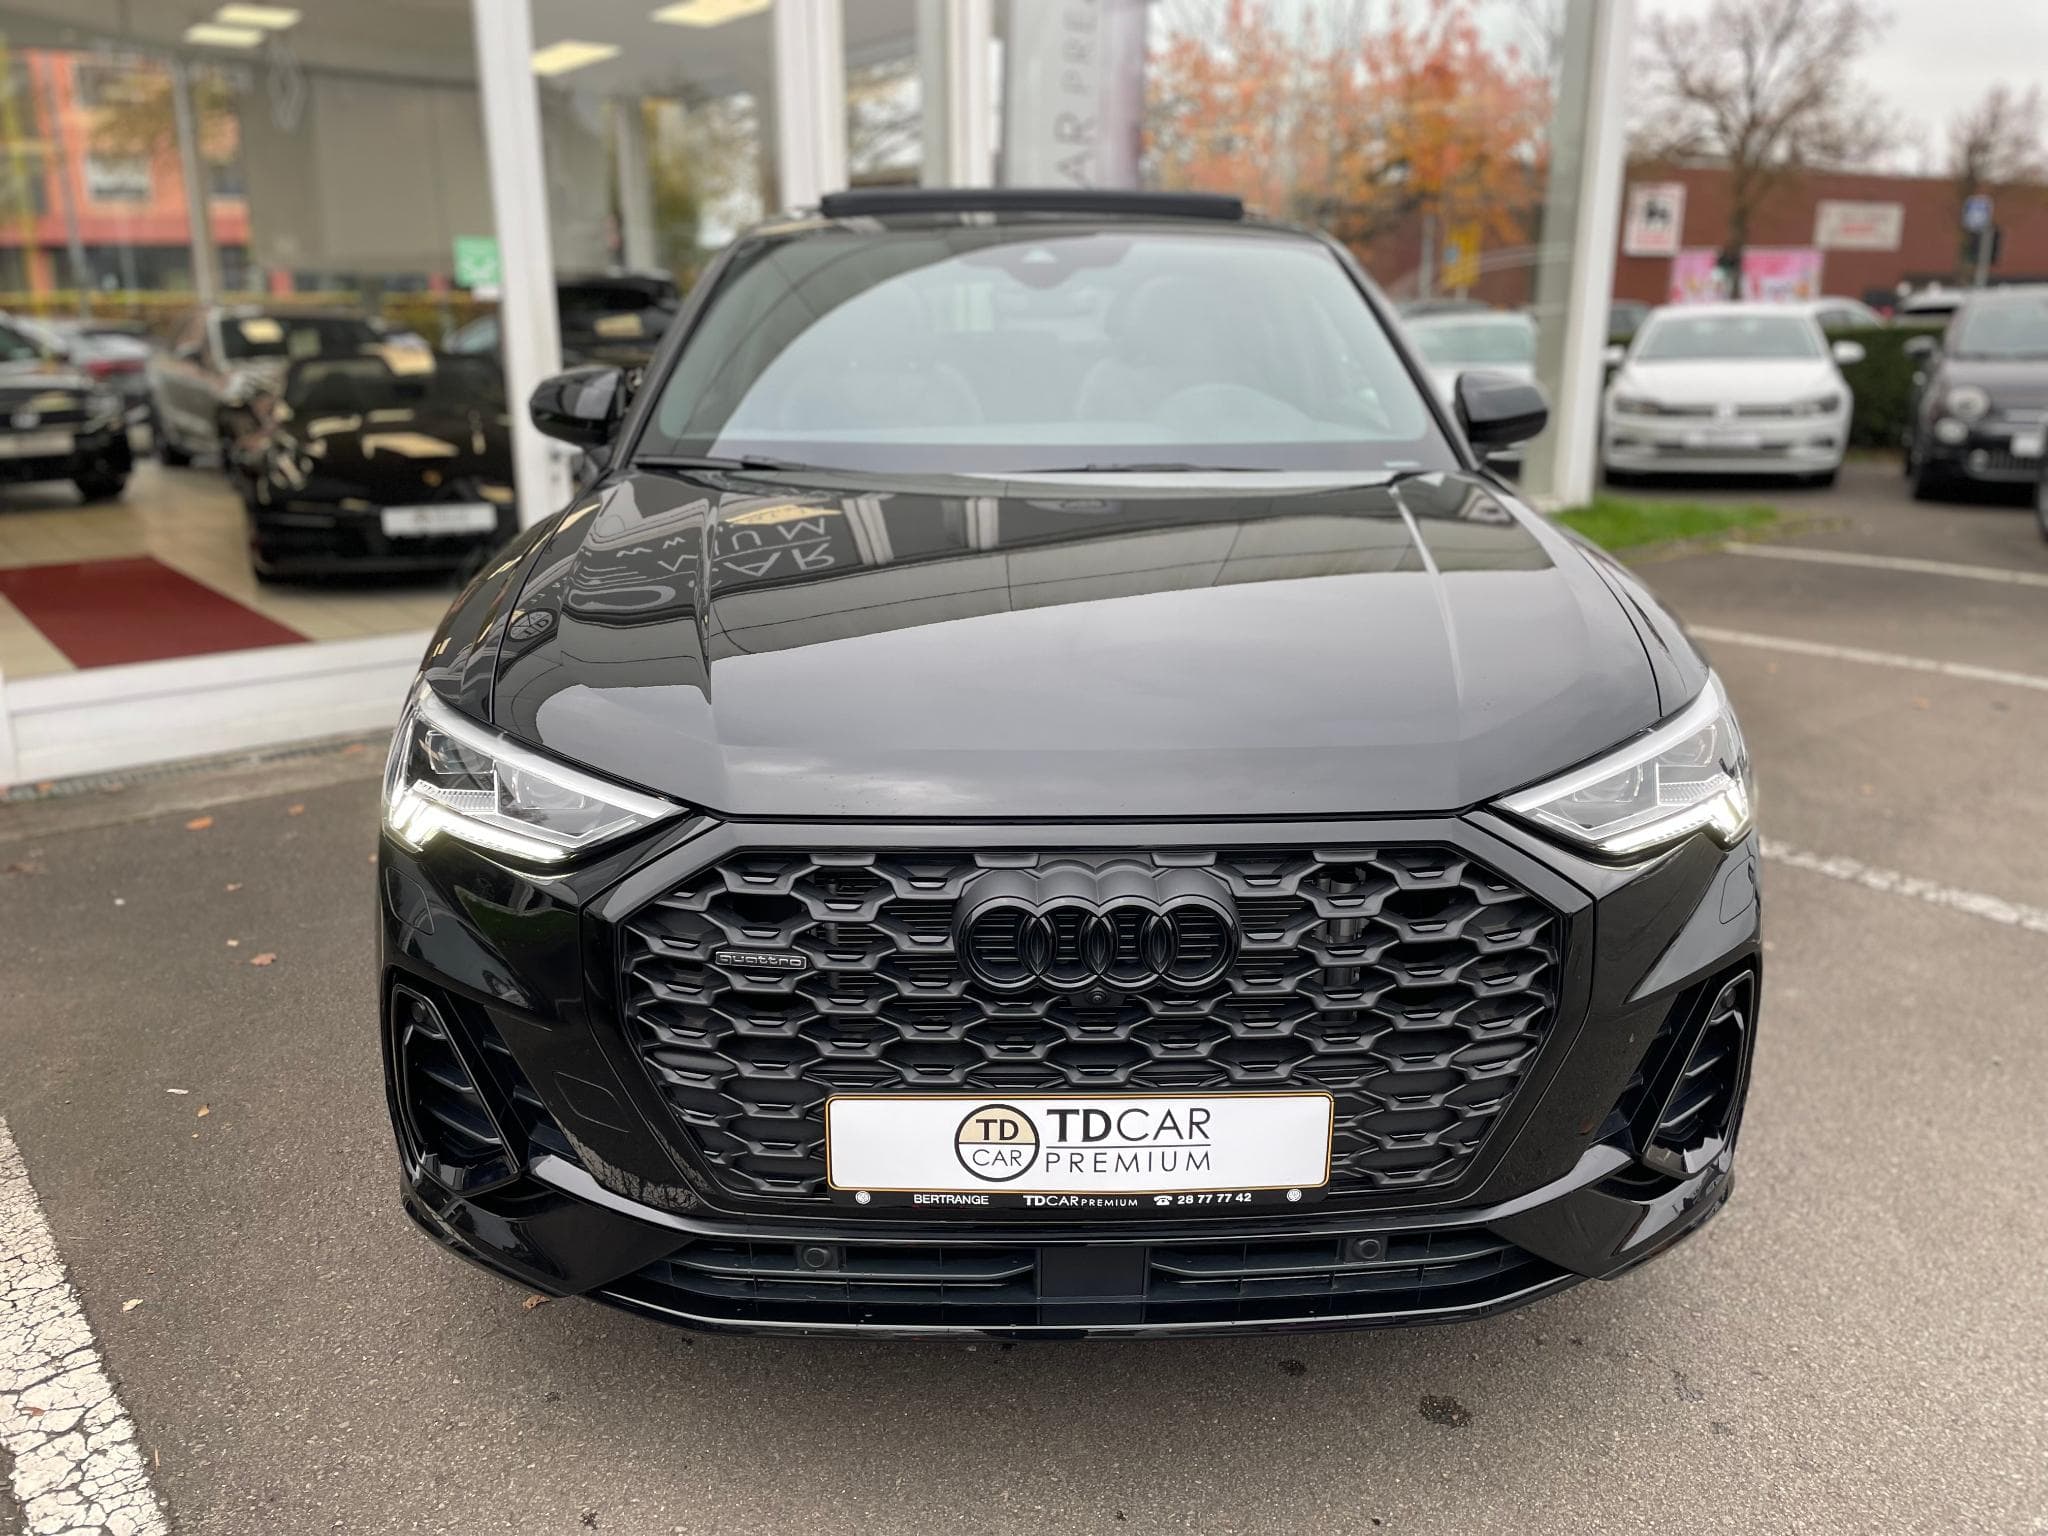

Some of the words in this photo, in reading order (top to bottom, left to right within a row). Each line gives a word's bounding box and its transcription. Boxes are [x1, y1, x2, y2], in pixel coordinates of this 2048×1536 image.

[1061, 0, 1097, 95] PRE
[718, 954, 803, 967] quattro
[976, 1118, 1020, 1141] TD
[1046, 1108, 1211, 1143] TDCAR
[972, 1148, 1023, 1167] CAR
[1045, 1150, 1211, 1174] PREMIUM
[913, 1194, 990, 1205] BERTRANGE
[1177, 1195, 1194, 1205] 28
[1198, 1194, 1213, 1204] 77
[1216, 1193, 1233, 1203] 77
[1235, 1192, 1252, 1203] 42
